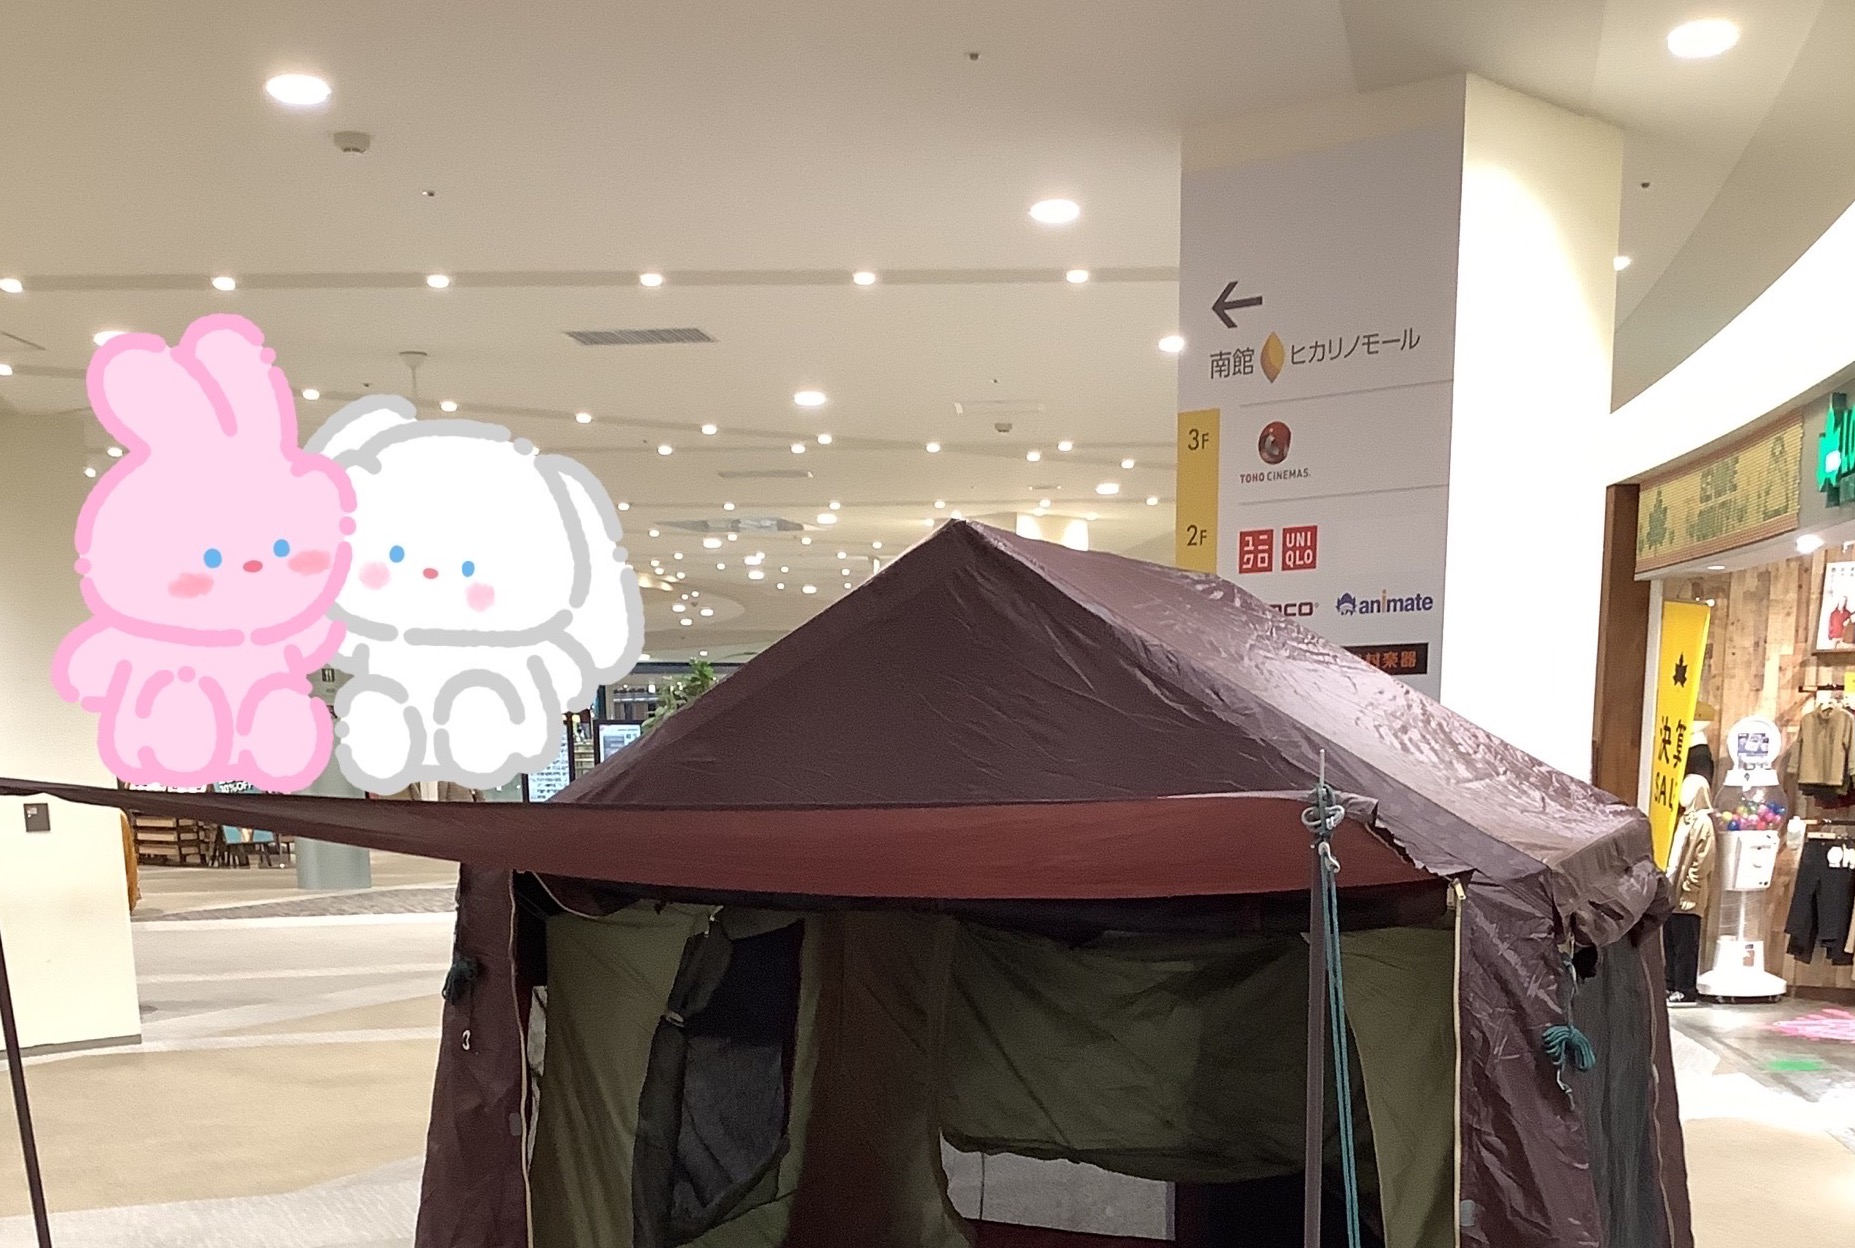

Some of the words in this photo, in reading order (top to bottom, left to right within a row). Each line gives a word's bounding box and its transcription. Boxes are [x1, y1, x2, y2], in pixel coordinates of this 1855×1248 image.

[1210, 347, 1255, 379] 南館
[1291, 327, 1421, 365] ヒカリノモール
[1187, 428, 1210, 450] 3F
[1240, 472, 1265, 484] TOHO
[1267, 468, 1310, 482] CINEMAS
[1186, 524, 1207, 546] 2F
[1358, 589, 1434, 614] animate
[1358, 650, 1417, 669] 村楽器
[1658, 716, 1687, 768] 決算
